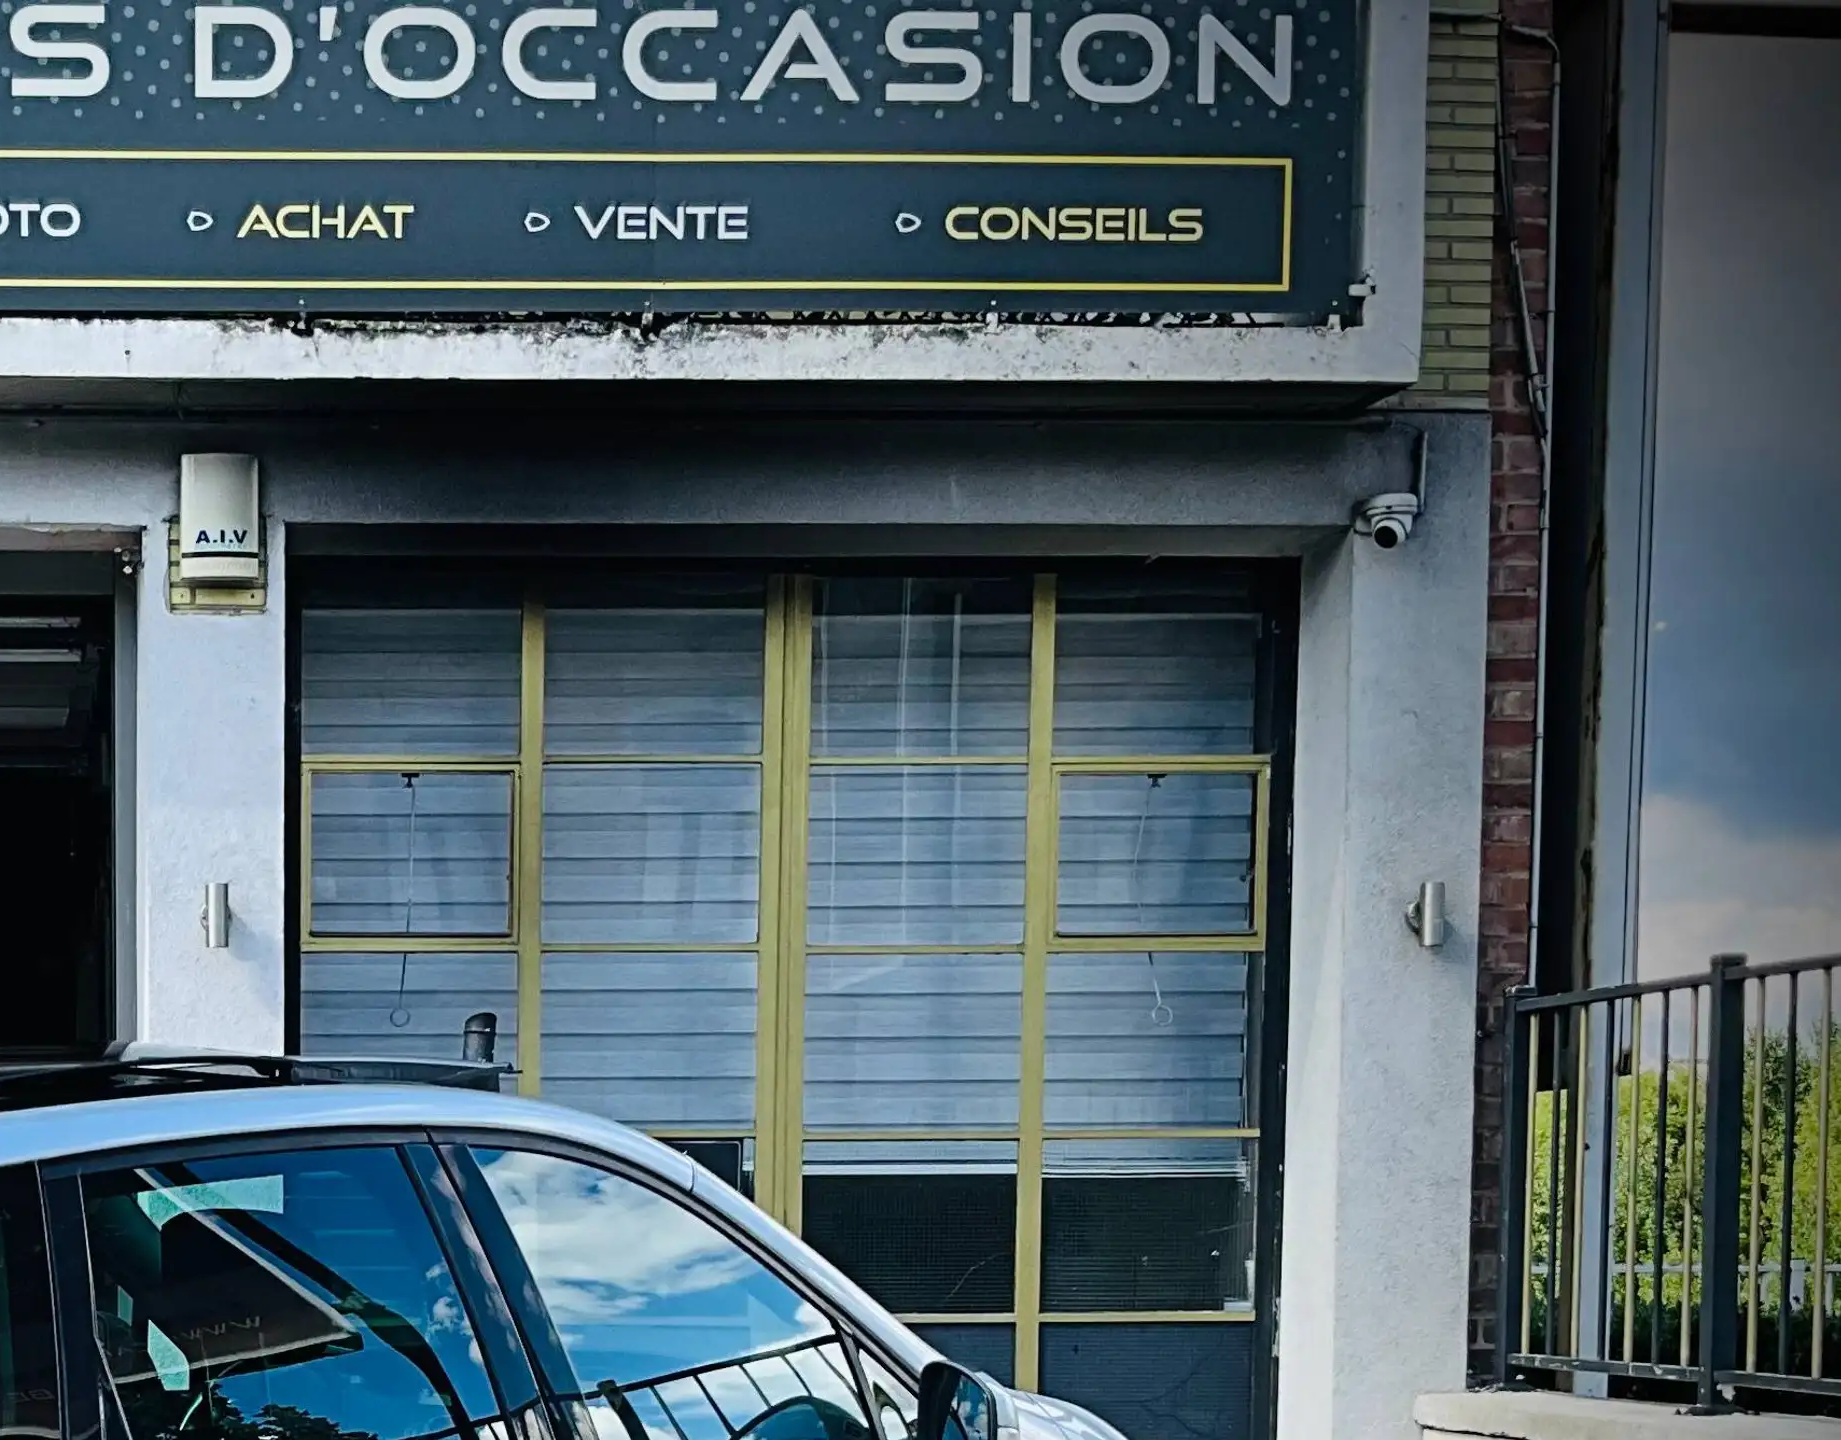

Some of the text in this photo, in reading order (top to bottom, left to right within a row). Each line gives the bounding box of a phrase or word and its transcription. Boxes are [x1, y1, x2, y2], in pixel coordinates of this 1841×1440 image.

[194, 5, 1293, 106] D'OCCASION
[235, 203, 415, 239] ACHAT
[573, 205, 749, 241] VENTE
[945, 206, 1203, 242] CONSEILS
